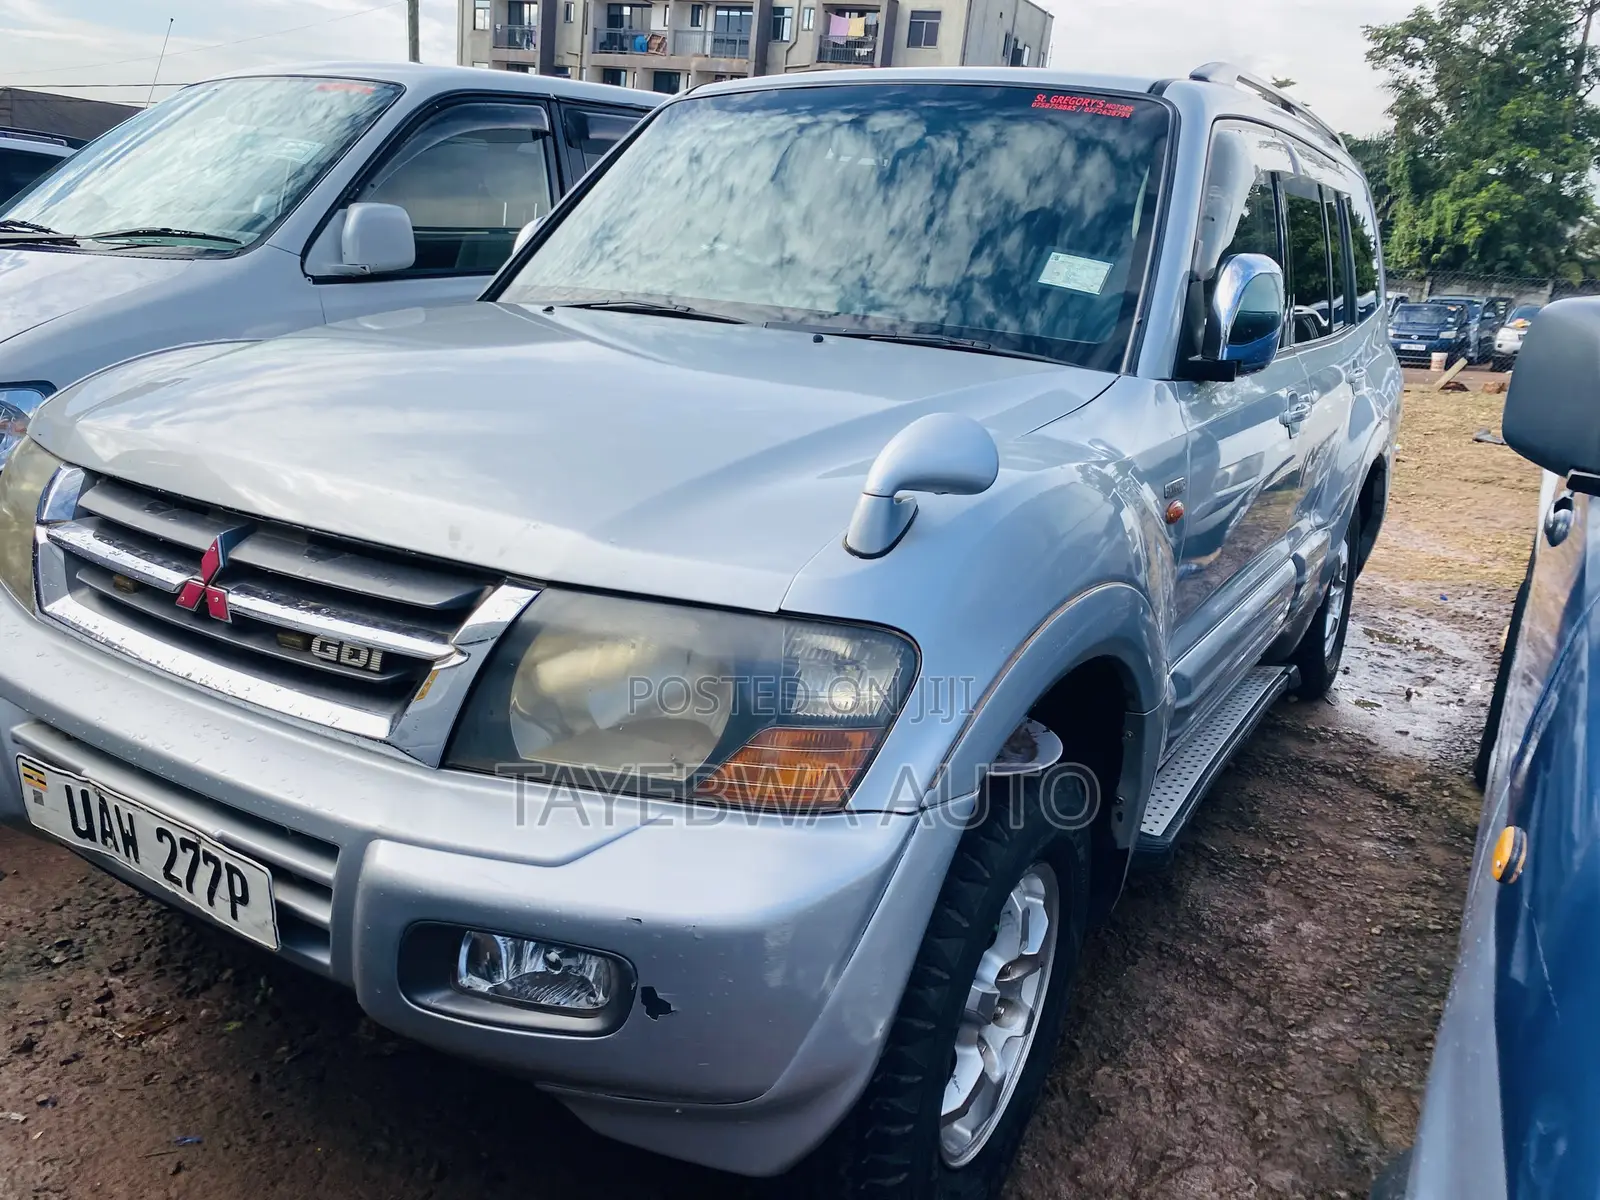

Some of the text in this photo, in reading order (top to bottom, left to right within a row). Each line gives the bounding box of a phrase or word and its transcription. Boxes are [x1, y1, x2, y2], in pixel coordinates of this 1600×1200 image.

[1034, 94, 1135, 112] St. GREGORY'S MOTORS
[311, 636, 383, 672] GDI
[155, 825, 250, 923] 277P
